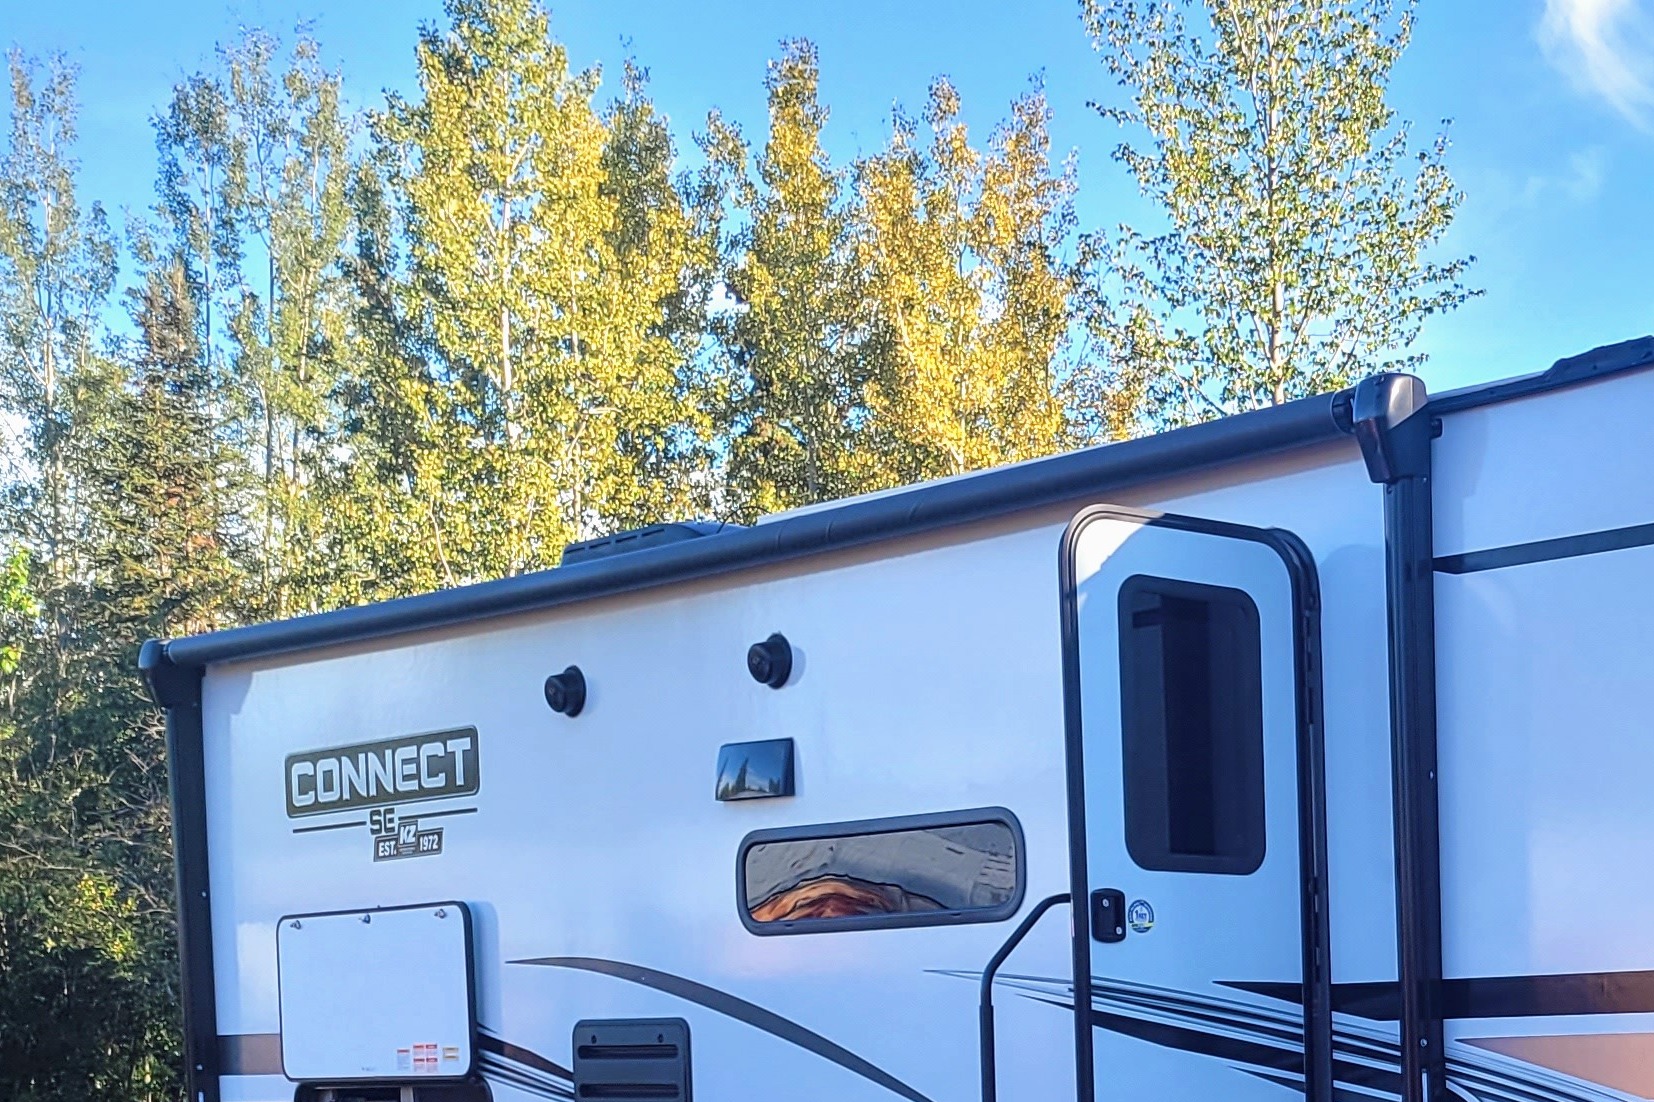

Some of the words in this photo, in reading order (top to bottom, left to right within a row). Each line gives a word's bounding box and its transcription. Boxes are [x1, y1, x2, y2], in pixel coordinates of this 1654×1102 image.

[291, 737, 471, 807] CONNECT
[369, 807, 396, 836] SE
[400, 824, 417, 845] KZ
[378, 840, 398, 857] EST.
[420, 833, 439, 852] 1972
